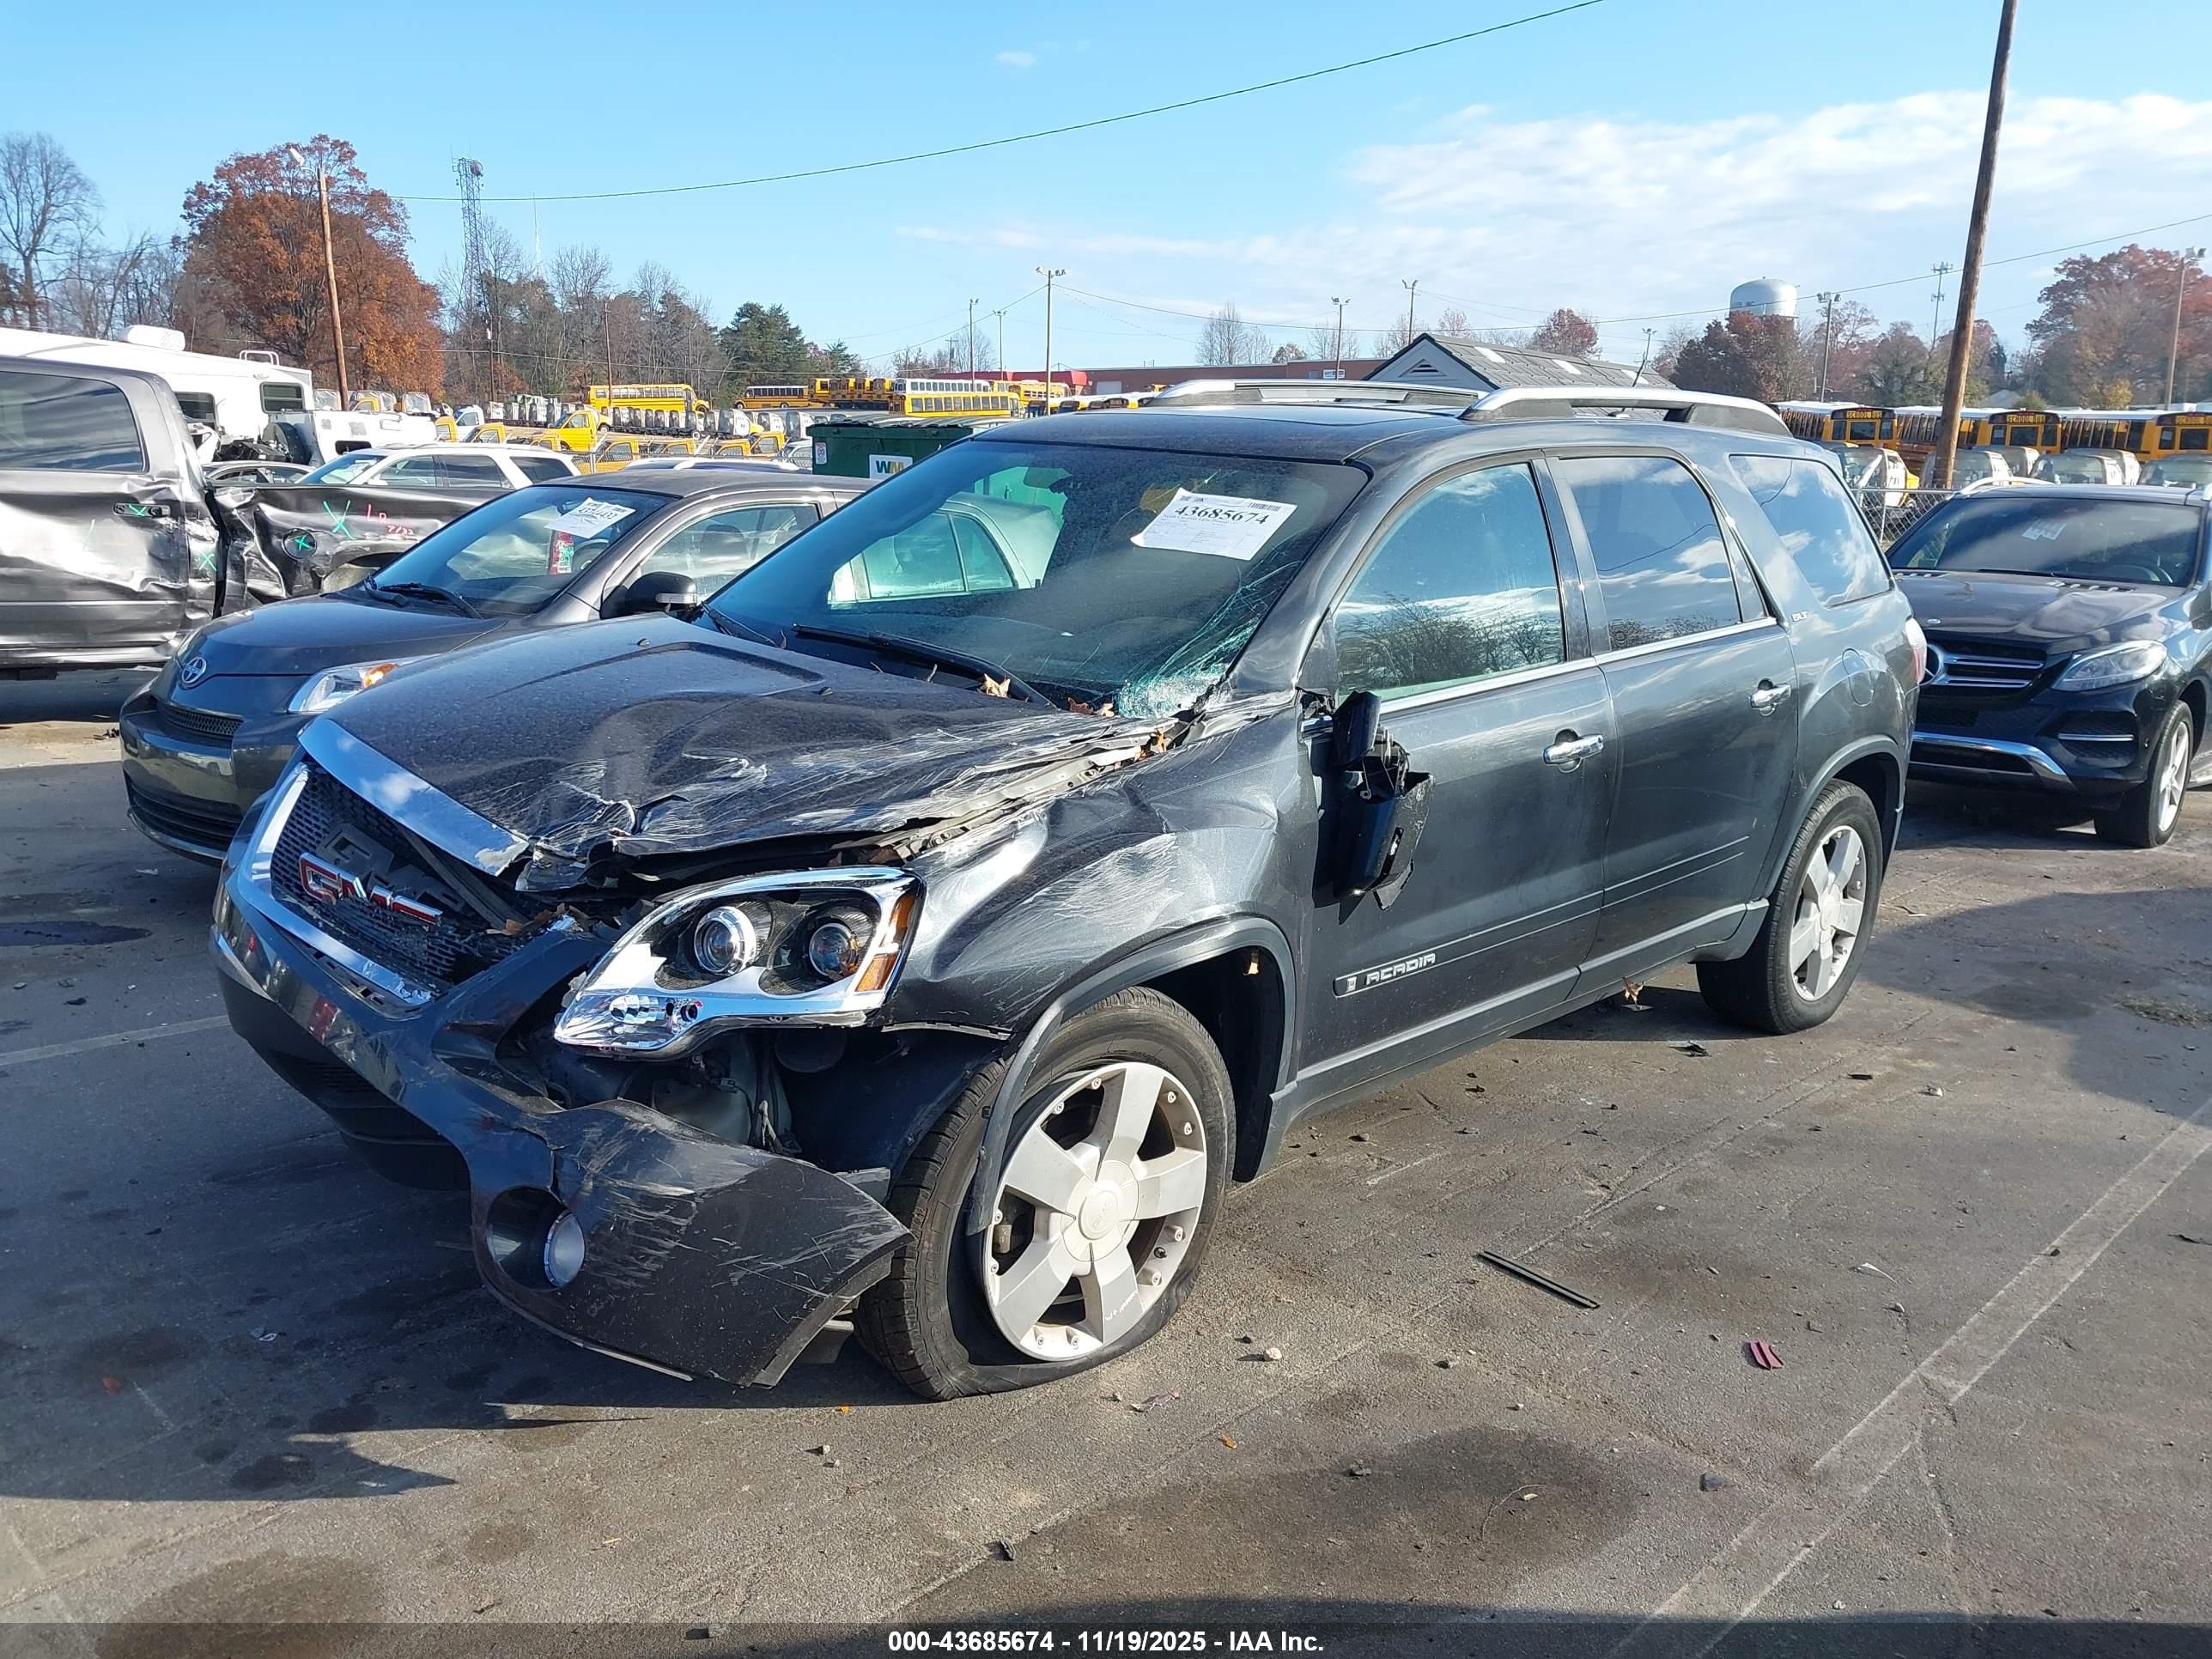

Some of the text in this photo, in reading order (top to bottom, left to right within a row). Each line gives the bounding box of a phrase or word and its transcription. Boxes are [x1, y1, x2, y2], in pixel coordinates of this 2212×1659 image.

[876, 459, 904, 475] WM
[1174, 505, 1270, 525] 43685674
[1365, 952, 1437, 986] ACADIA
